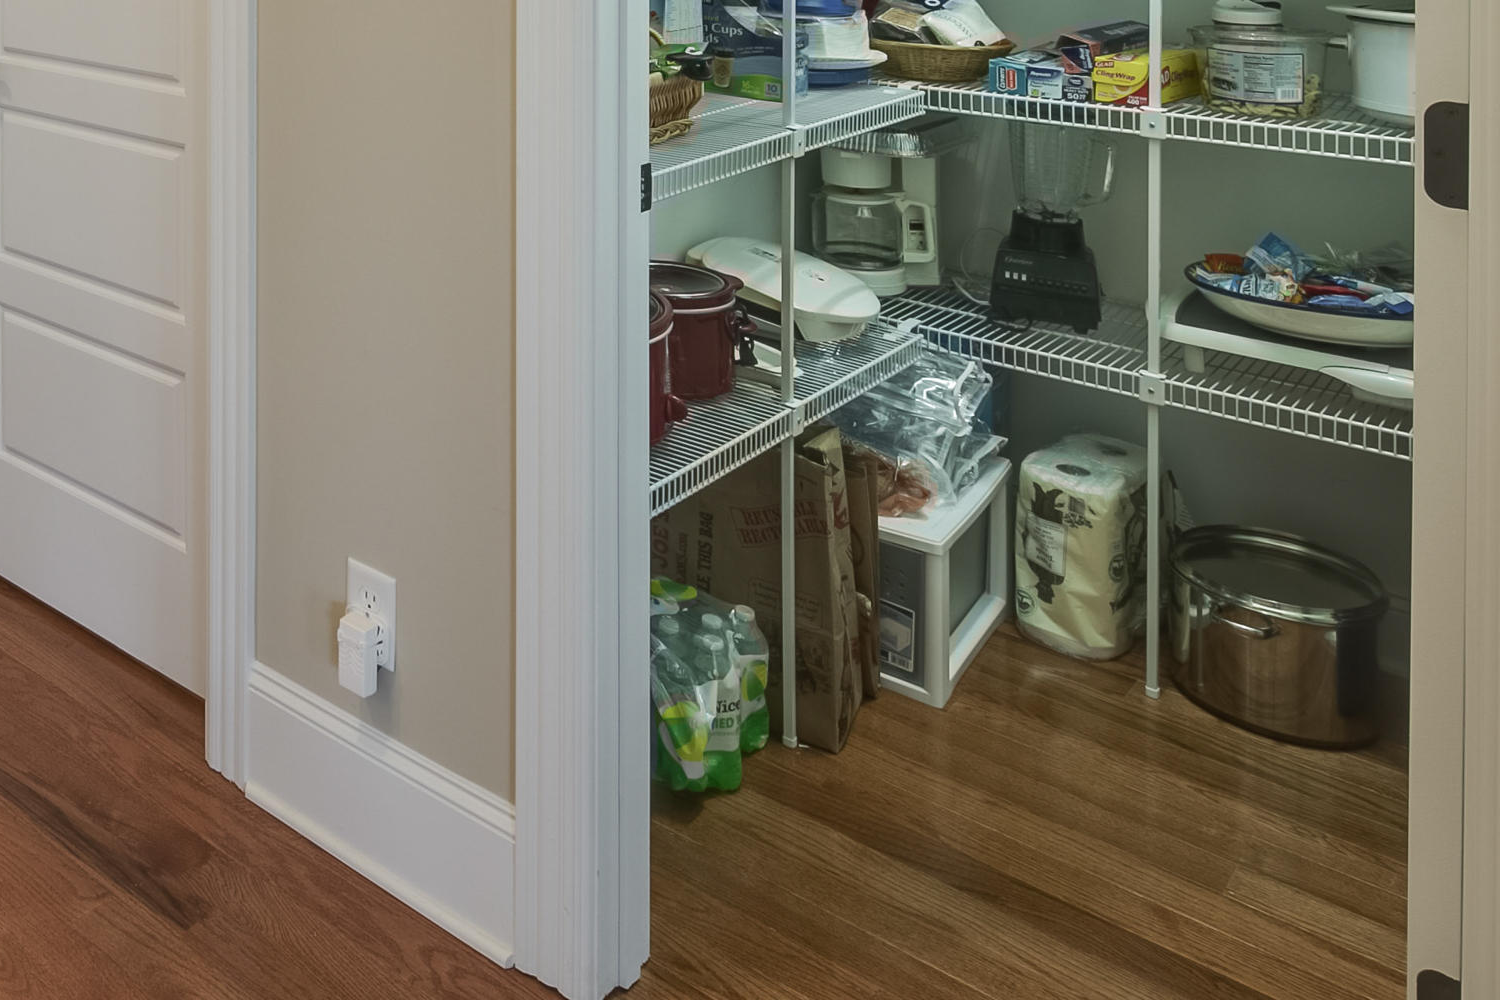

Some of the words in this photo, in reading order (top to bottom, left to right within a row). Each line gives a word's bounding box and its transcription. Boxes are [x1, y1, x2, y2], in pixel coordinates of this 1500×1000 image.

[711, 23, 743, 37] Cups
[1066, 92, 1079, 100] 50
[698, 511, 713, 538] BAG
[697, 540, 712, 570] THIS
